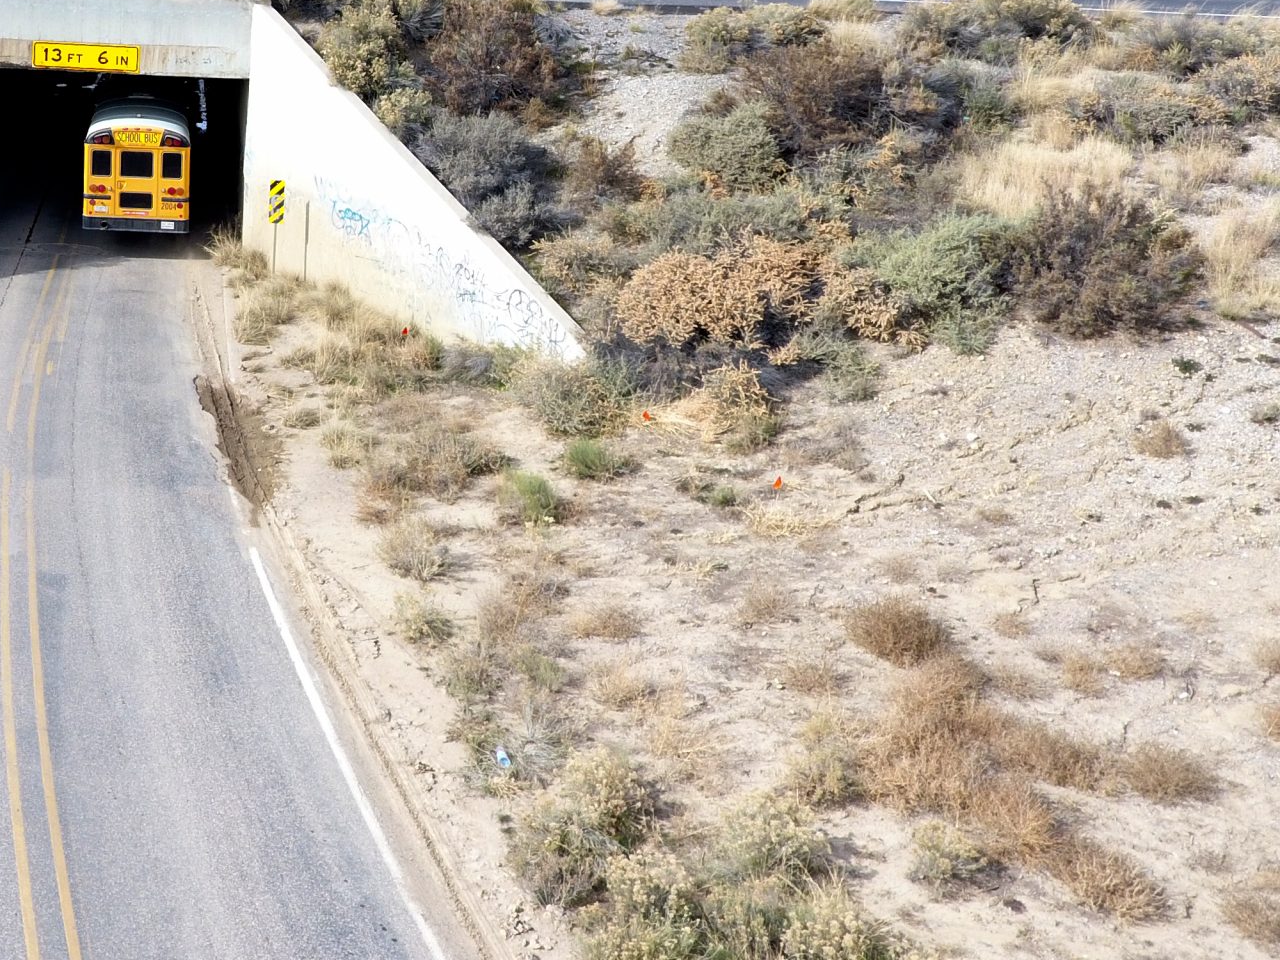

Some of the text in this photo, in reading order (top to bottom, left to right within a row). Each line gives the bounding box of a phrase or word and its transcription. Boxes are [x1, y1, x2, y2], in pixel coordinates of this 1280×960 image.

[44, 47, 129, 66] 13 FT 6 IN
[117, 131, 158, 144] SCHOOL BUS
[161, 202, 177, 211] 2004
